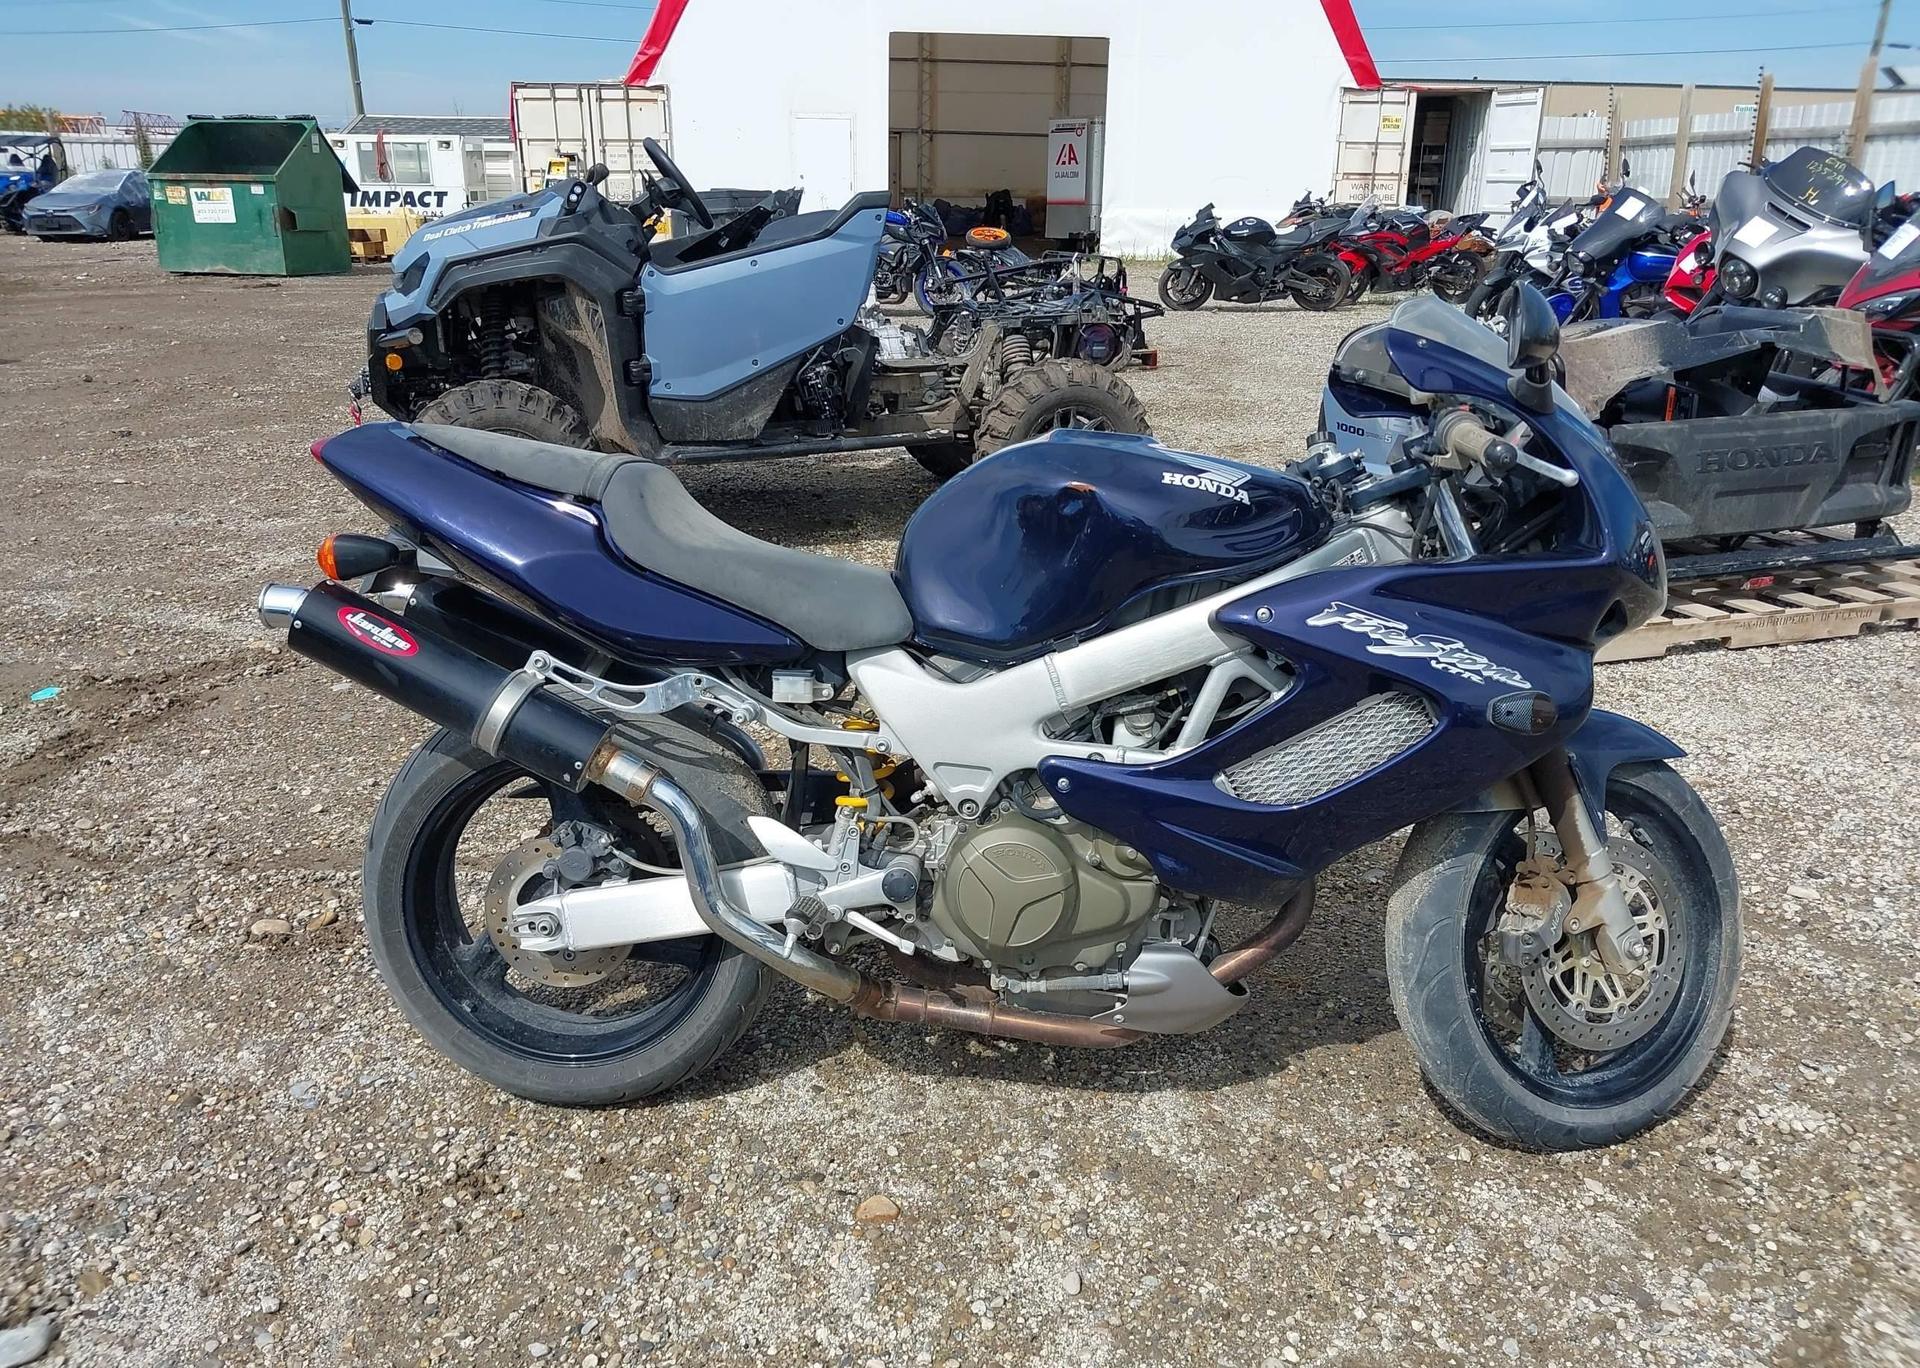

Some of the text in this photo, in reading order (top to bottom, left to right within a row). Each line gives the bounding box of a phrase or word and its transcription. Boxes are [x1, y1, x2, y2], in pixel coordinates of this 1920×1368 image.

[349, 190, 449, 208] IMPACT
[1350, 183, 1394, 191] WARNING
[422, 210, 532, 242] Dual Clutch Transmission
[1336, 421, 1365, 437] 1000
[1696, 441, 1838, 474] HONDA
[1161, 471, 1251, 506] HONDA
[345, 612, 412, 651] Jardine
[1430, 659, 1485, 685] VTR
